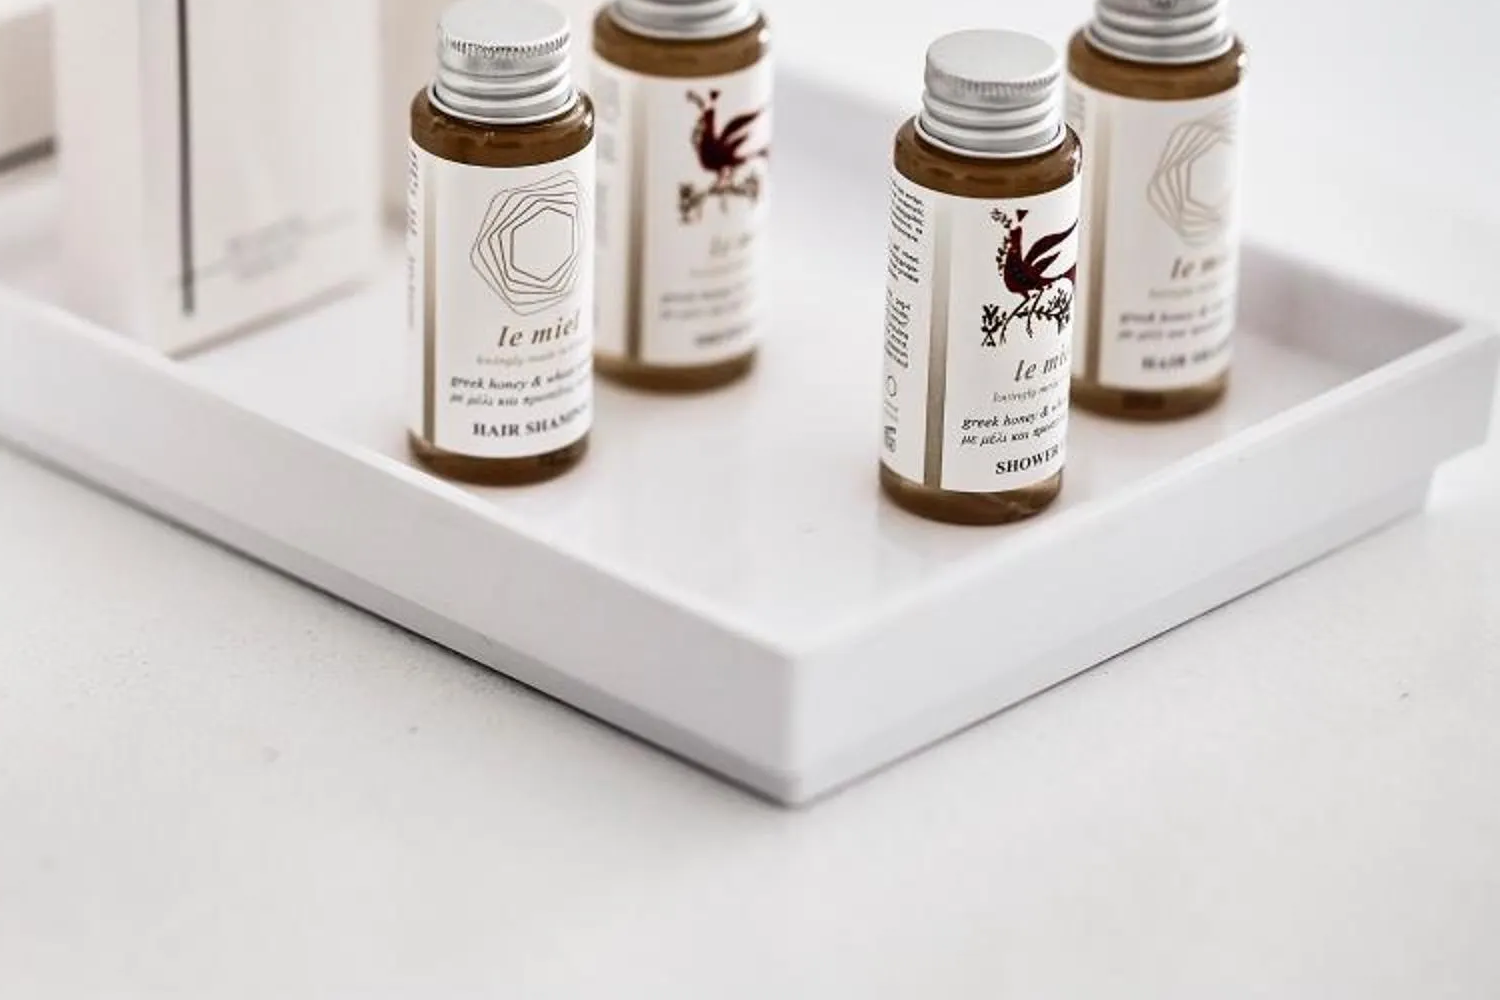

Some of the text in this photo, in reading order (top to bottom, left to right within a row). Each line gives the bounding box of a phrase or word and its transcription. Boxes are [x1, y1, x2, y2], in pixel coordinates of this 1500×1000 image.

[498, 325, 523, 348] le
[531, 308, 580, 345] miel
[1014, 359, 1037, 382] le
[472, 422, 520, 438] HAIR
[961, 415, 999, 431] greek
[1003, 413, 1036, 426] honey
[995, 444, 1059, 475] SHOWER
